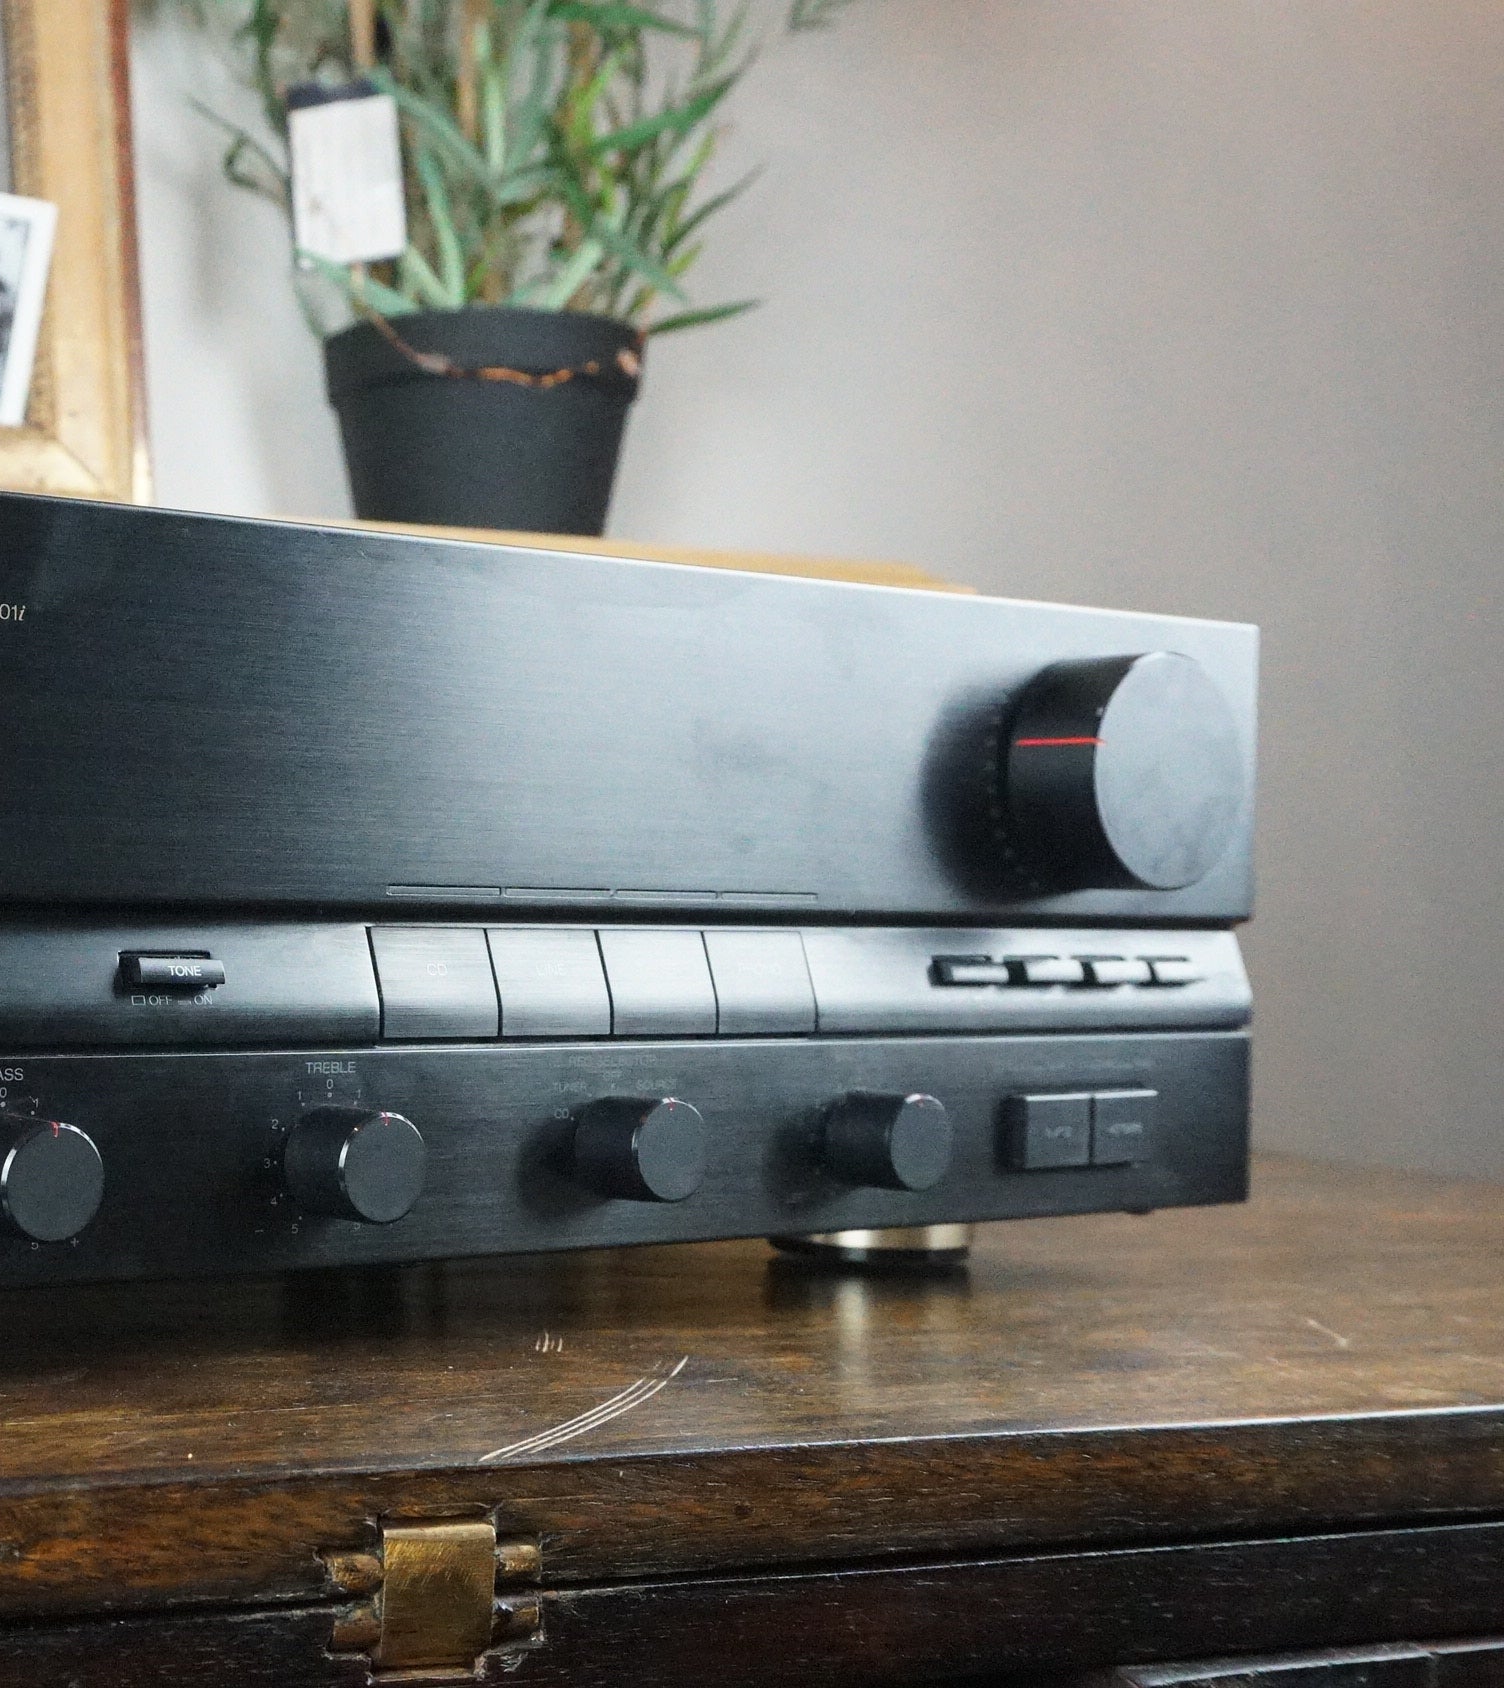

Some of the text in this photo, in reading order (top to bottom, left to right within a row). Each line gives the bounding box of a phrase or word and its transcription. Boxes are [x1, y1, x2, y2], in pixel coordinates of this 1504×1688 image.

[167, 964, 203, 977] TONE
[425, 962, 449, 977] CD
[148, 994, 214, 1006] OFF ON
[304, 1061, 357, 1075] TREBLE
[326, 1078, 334, 1089] 0
[271, 1118, 279, 1130] 2
[263, 1158, 271, 1169] 3
[291, 1223, 299, 1235] 5
